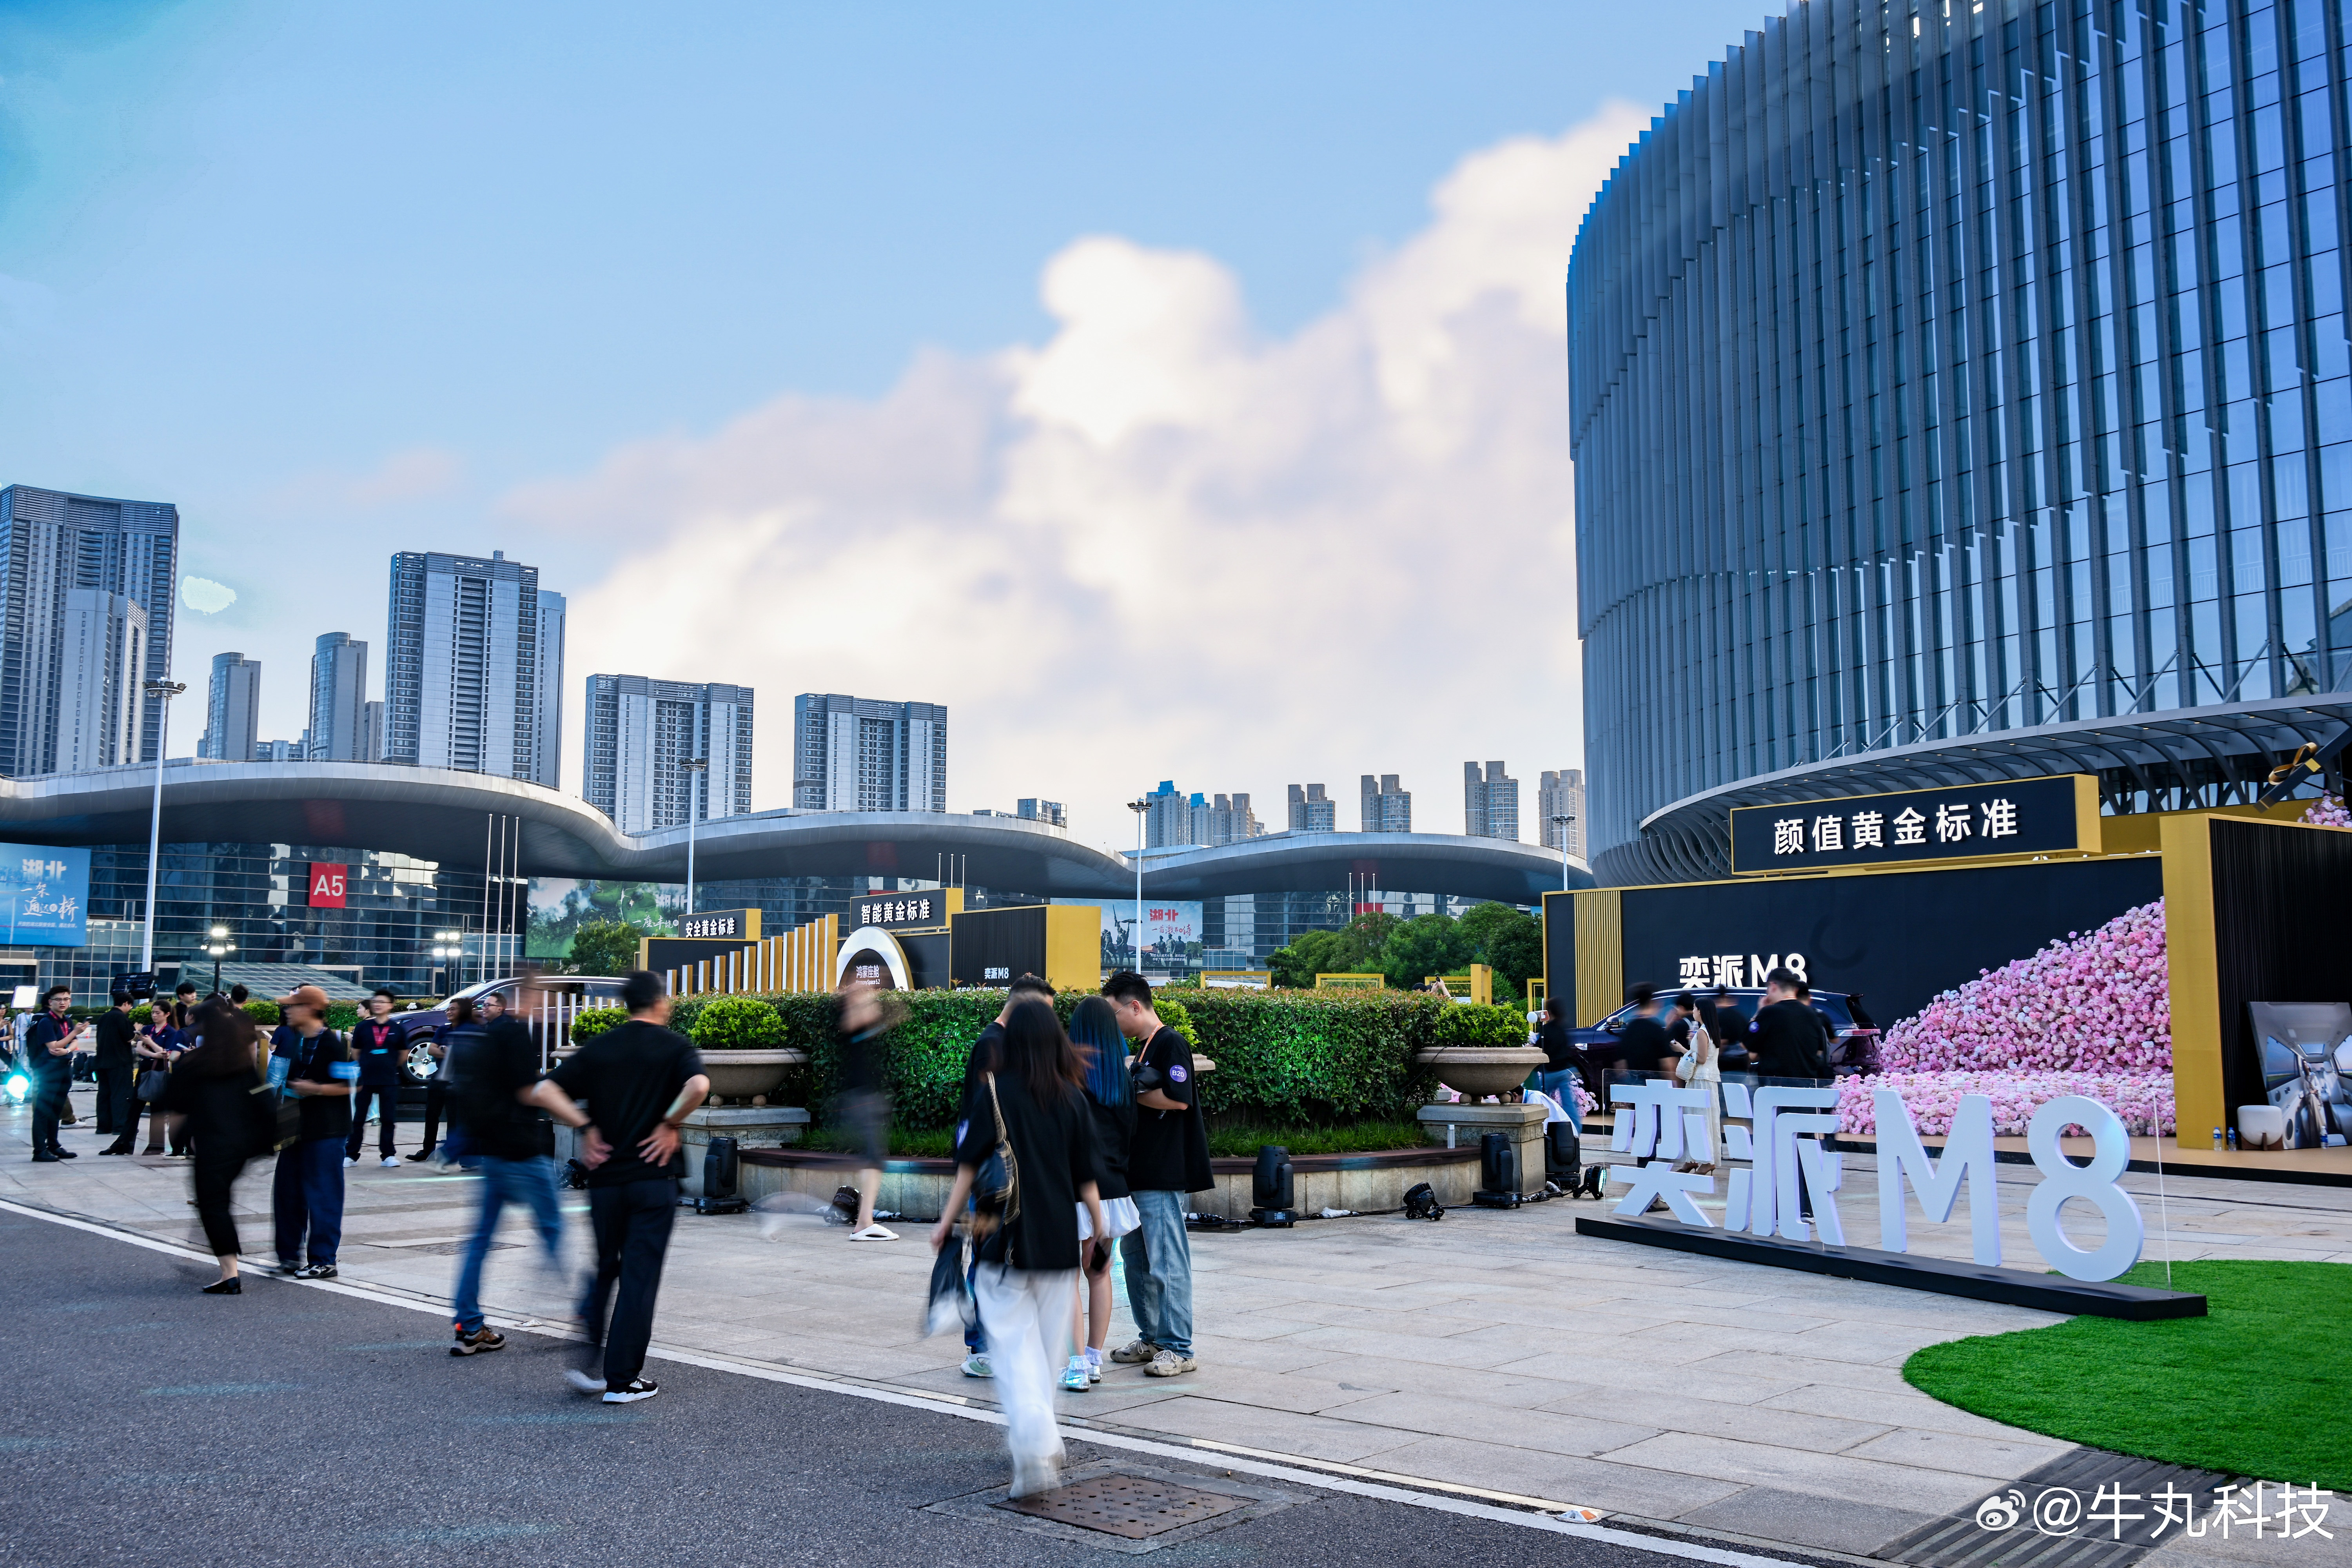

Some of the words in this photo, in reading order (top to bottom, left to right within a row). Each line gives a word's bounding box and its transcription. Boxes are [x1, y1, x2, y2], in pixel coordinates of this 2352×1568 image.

[1773, 798, 2018, 856] 颜值黄金标准
[22, 859, 67, 882] 湖北
[313, 875, 343, 897] A5
[861, 898, 930, 924] 智能黄金标准
[1149, 909, 1179, 922] 湖北
[685, 917, 735, 938] 安全黄金标准
[856, 965, 879, 978] 鸿蒙座舱
[984, 967, 1009, 979] 奕派M8
[1679, 953, 1808, 988] 奕派M8
[1610, 1079, 2143, 1281] 奕派M8
